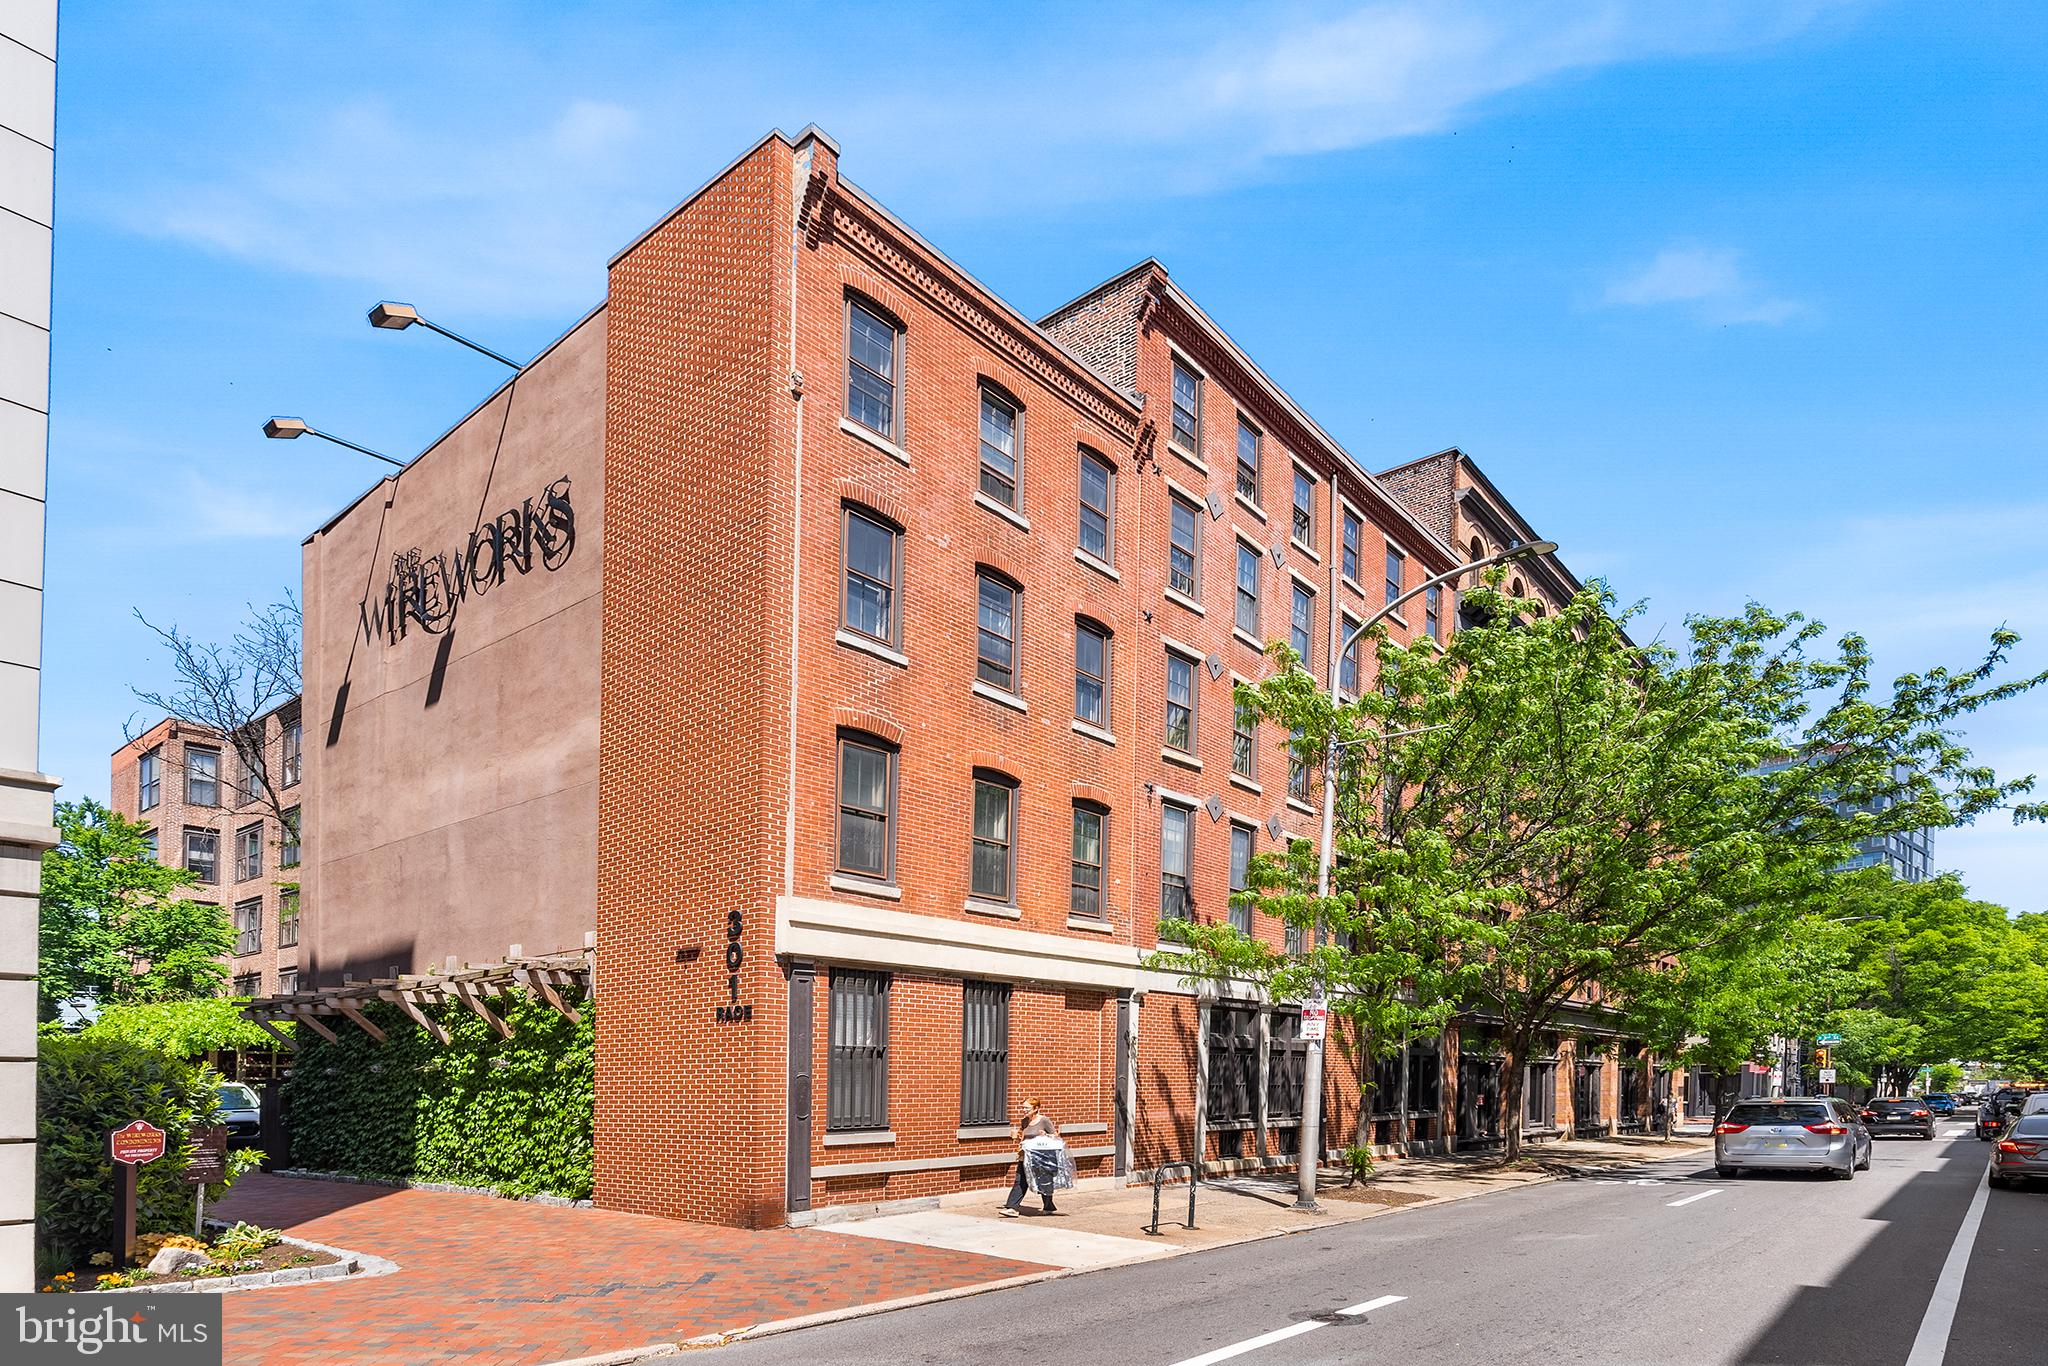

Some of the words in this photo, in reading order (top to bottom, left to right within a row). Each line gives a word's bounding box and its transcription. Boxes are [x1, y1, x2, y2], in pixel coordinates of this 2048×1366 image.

[359, 475, 576, 647] WIREWORKS
[727, 911, 743, 1003] 301
[716, 1005, 753, 1023] RACE
